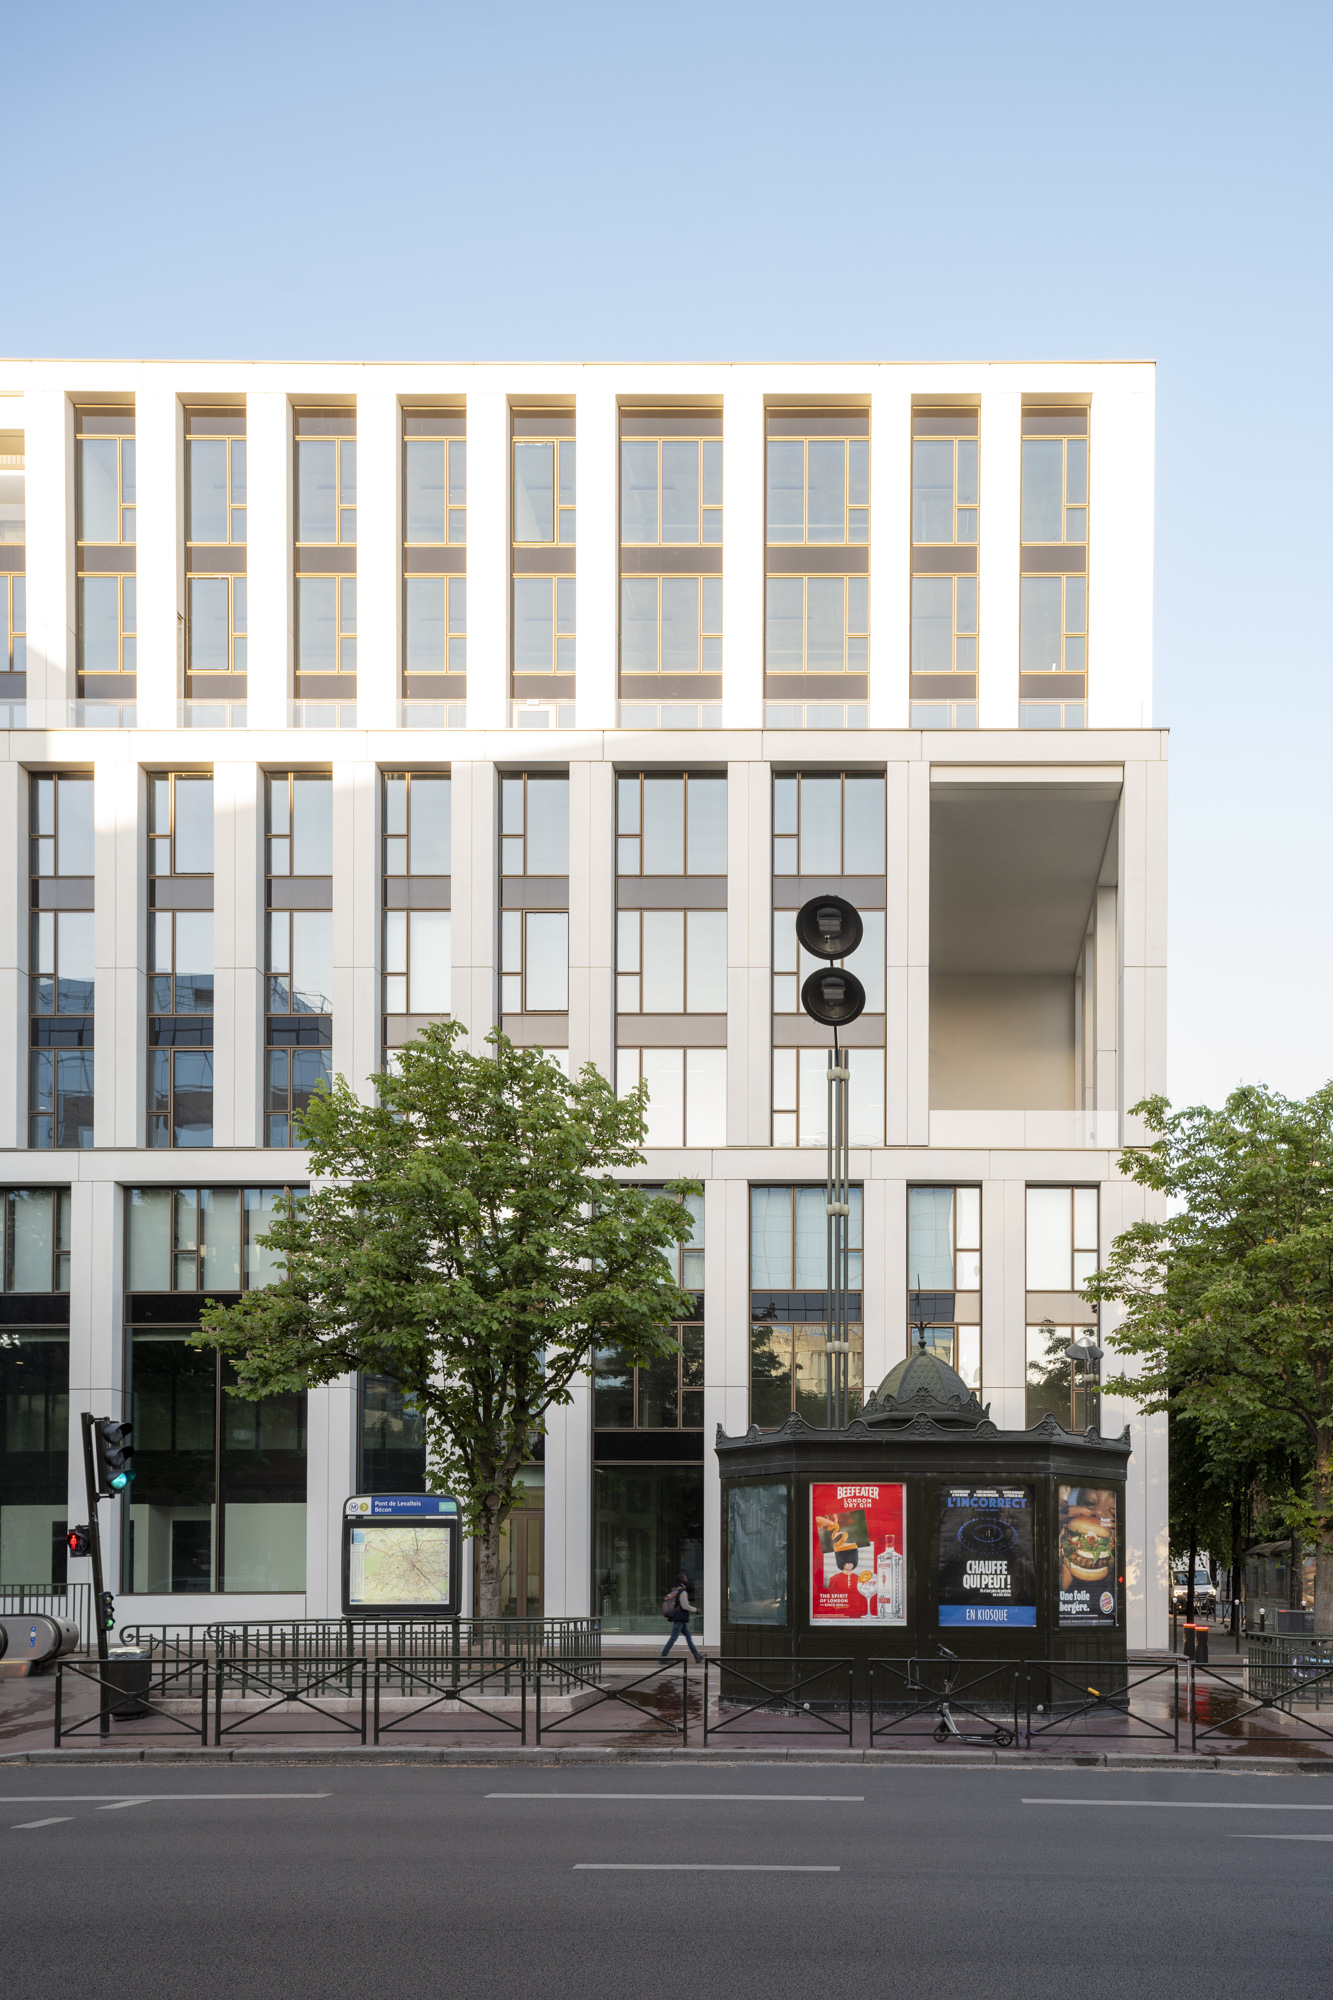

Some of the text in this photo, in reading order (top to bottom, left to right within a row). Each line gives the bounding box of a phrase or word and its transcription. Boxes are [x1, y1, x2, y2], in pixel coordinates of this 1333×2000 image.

[837, 1486, 879, 1499] BEEFEATER
[947, 1497, 1027, 1508] L'INCORRECT
[966, 1560, 1008, 1574] CHAUFFE
[962, 1574, 980, 1589] QUI
[1060, 1590, 1090, 1601] Une folie
[1059, 1601, 1090, 1614] bergère.
[966, 1608, 1008, 1621] EN KIOSQUE
